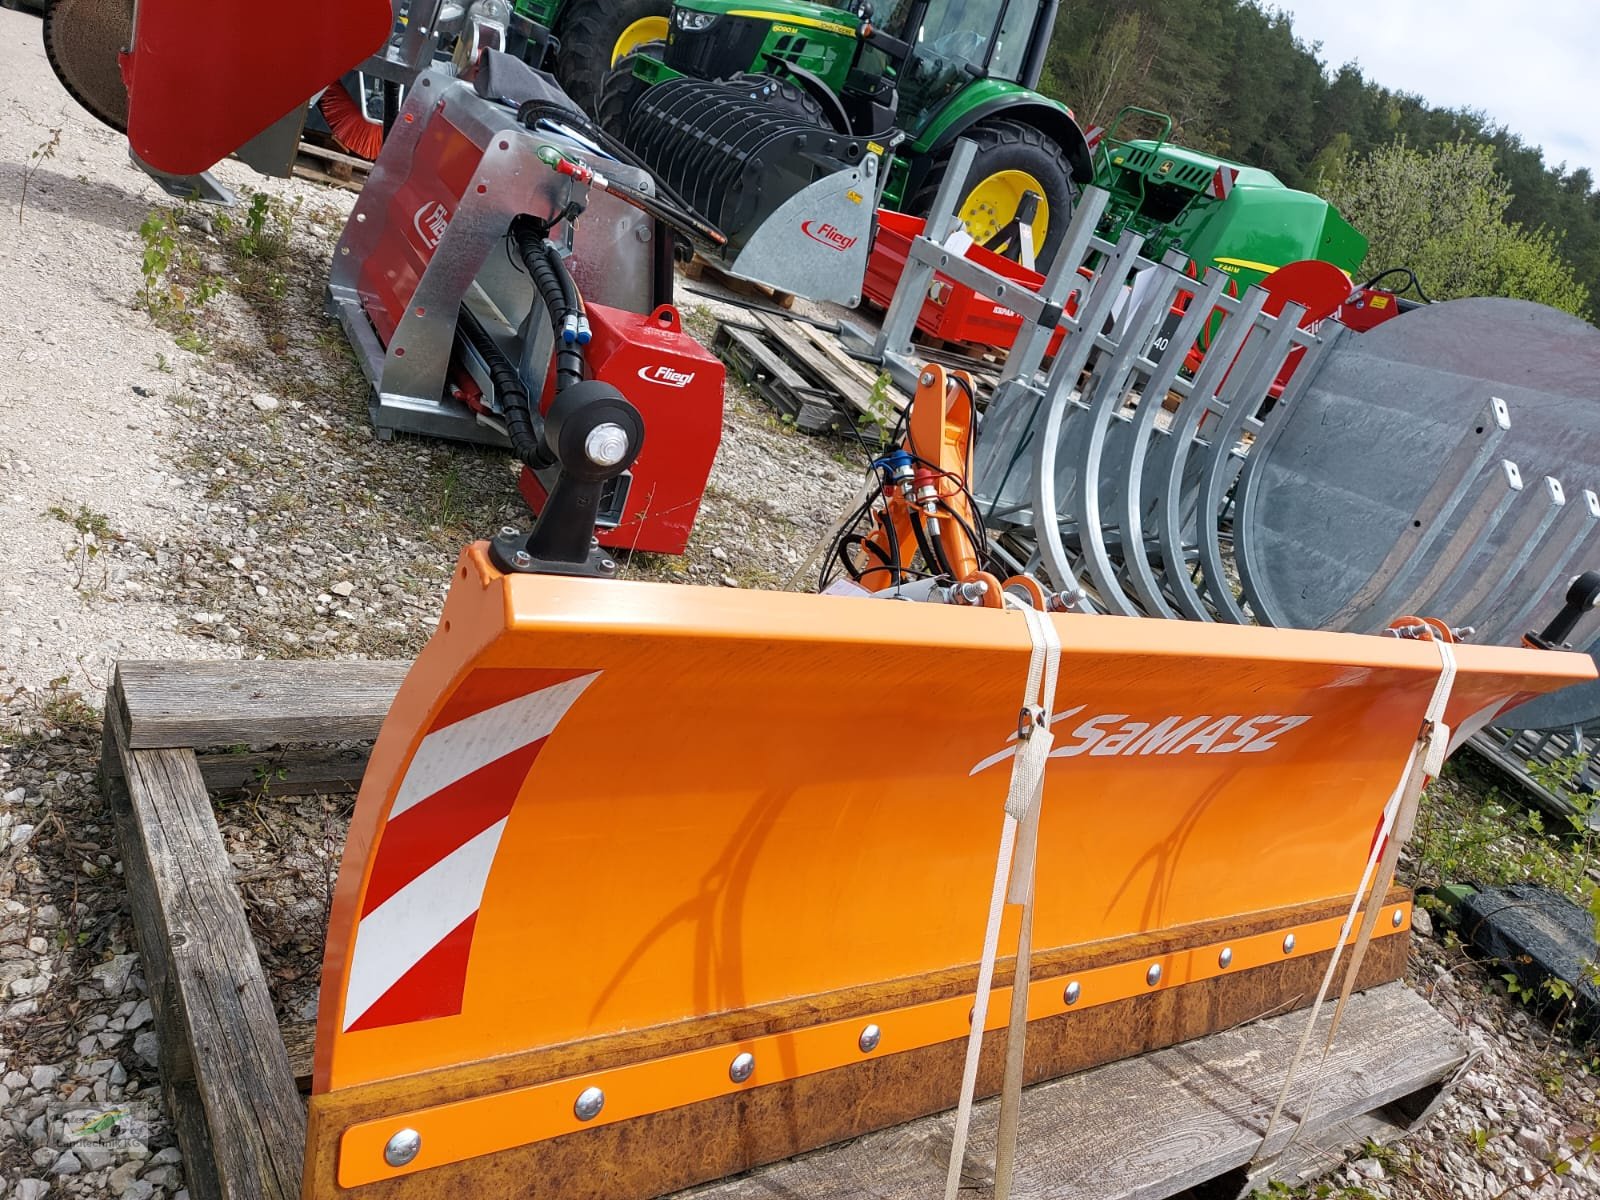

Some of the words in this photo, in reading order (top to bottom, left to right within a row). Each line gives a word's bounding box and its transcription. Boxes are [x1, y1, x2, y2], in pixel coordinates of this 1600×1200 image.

[817, 223, 858, 250] Fliegl
[654, 366, 695, 386] Fliegl
[1050, 713, 1313, 758] SaMASZ
